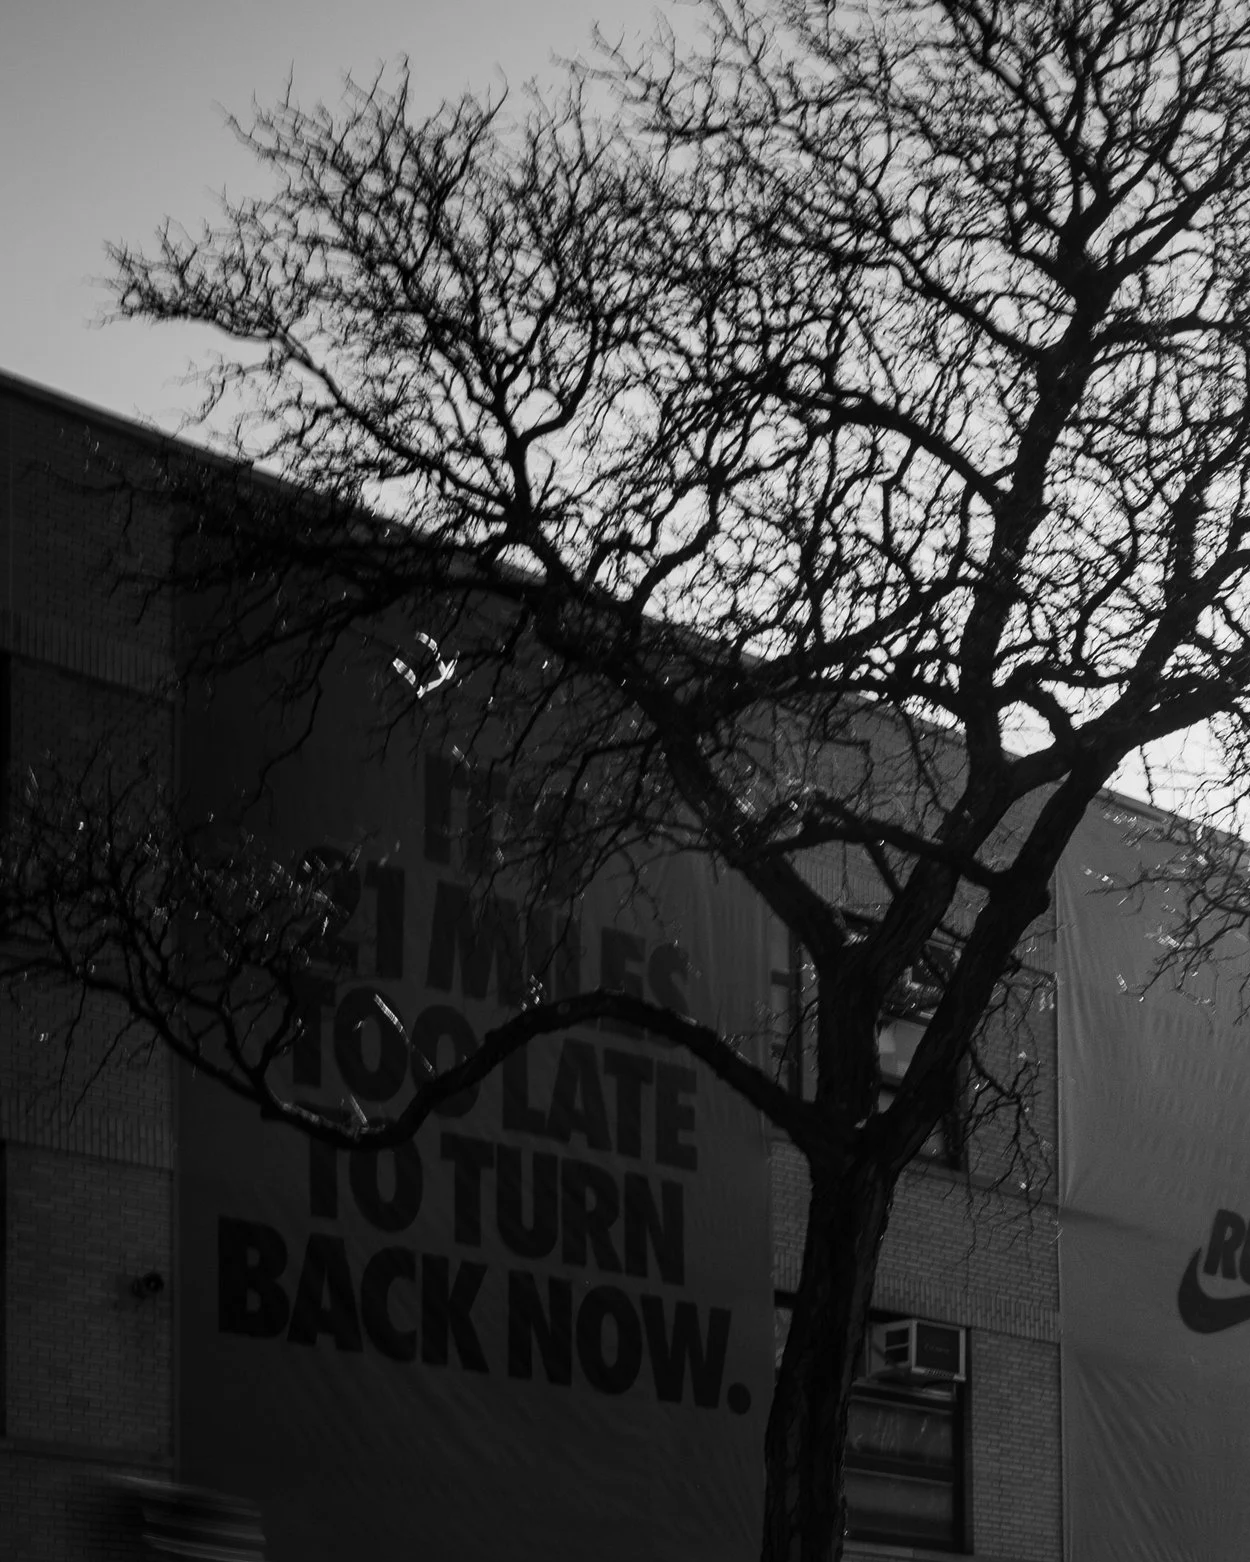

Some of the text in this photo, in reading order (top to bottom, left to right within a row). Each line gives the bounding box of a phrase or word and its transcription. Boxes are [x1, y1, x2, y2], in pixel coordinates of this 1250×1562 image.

[284, 969, 697, 1171] TOO LATE
[297, 1101, 684, 1285] TO TURN
[218, 1216, 751, 1415] BACK NOW.
